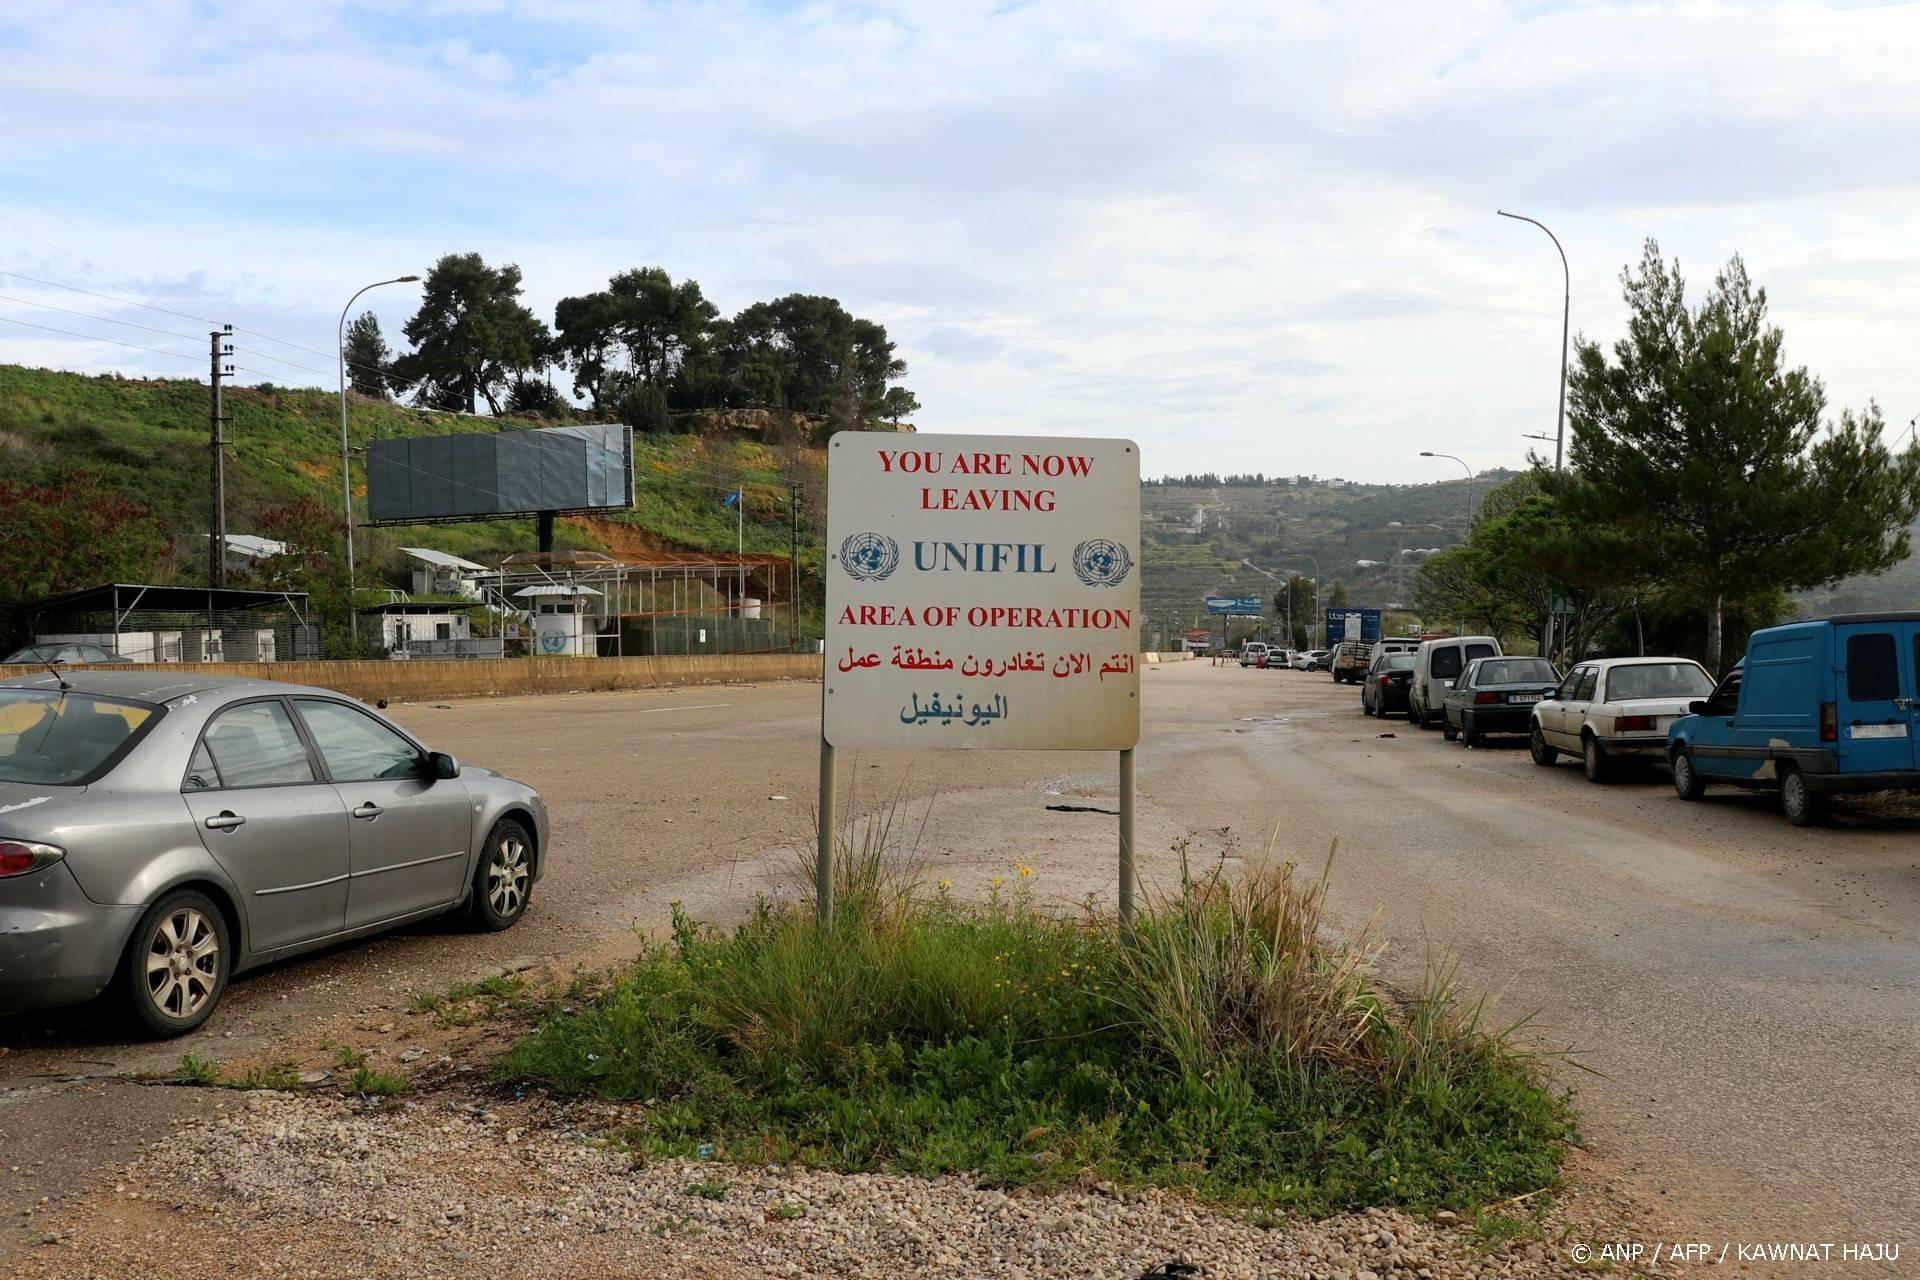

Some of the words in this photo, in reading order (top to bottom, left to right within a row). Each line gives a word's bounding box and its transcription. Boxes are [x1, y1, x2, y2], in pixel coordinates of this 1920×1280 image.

[878, 450, 943, 473] YOU
[951, 453, 1012, 475] ARE
[1021, 454, 1095, 478] NOW
[920, 488, 1056, 512] LEAVING
[912, 541, 1057, 574] UNIFIL
[838, 605, 917, 626] AREA
[922, 606, 961, 627] OF
[967, 606, 1133, 630] OPERATION
[838, 646, 881, 672] عمل
[891, 645, 954, 670] منطقة
[961, 650, 1046, 678] تغادرون
[1052, 652, 1092, 678] الان
[1099, 653, 1135, 682] انتم
[900, 691, 1009, 727] اليونيفيل
